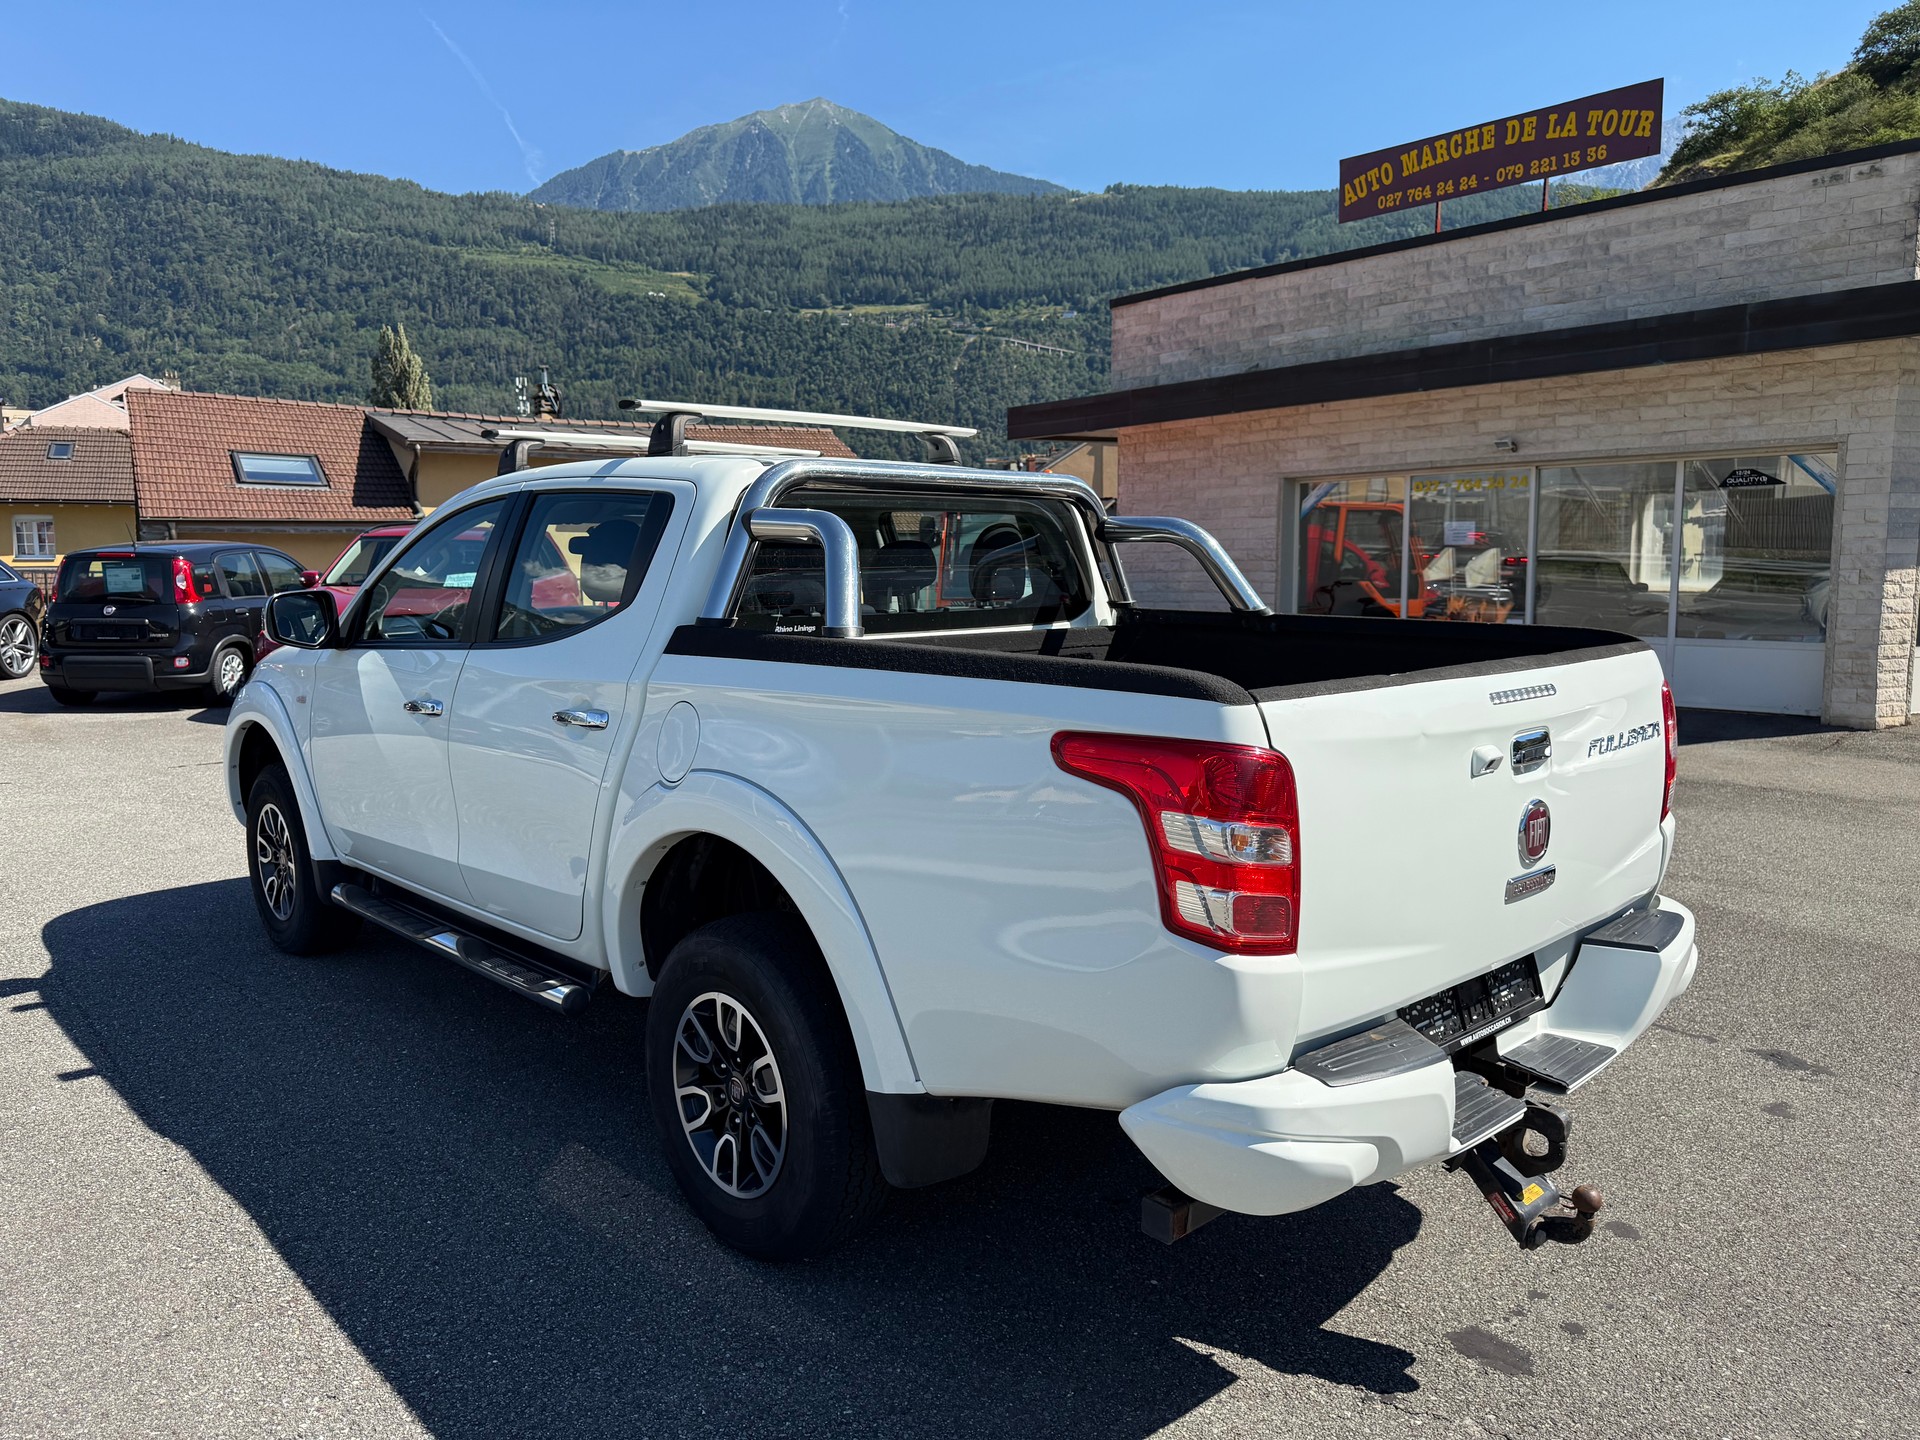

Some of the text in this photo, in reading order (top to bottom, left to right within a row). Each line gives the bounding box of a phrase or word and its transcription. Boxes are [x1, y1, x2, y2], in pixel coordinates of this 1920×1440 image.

[1344, 108, 1655, 207] AUTO MARCHE DE LA TOUR
[1377, 191, 1403, 210] 027
[1407, 185, 1432, 203] 764
[1436, 179, 1455, 197] 24
[1459, 174, 1478, 191] 24
[1496, 163, 1524, 183] 079
[1530, 156, 1558, 176] 221
[1563, 150, 1581, 169] 13
[1587, 144, 1608, 163] 36
[1456, 478, 1482, 491] 764
[1510, 475, 1529, 489] 24
[775, 624, 816, 633] Rhino Linings
[1528, 816, 1546, 849] FIAT
